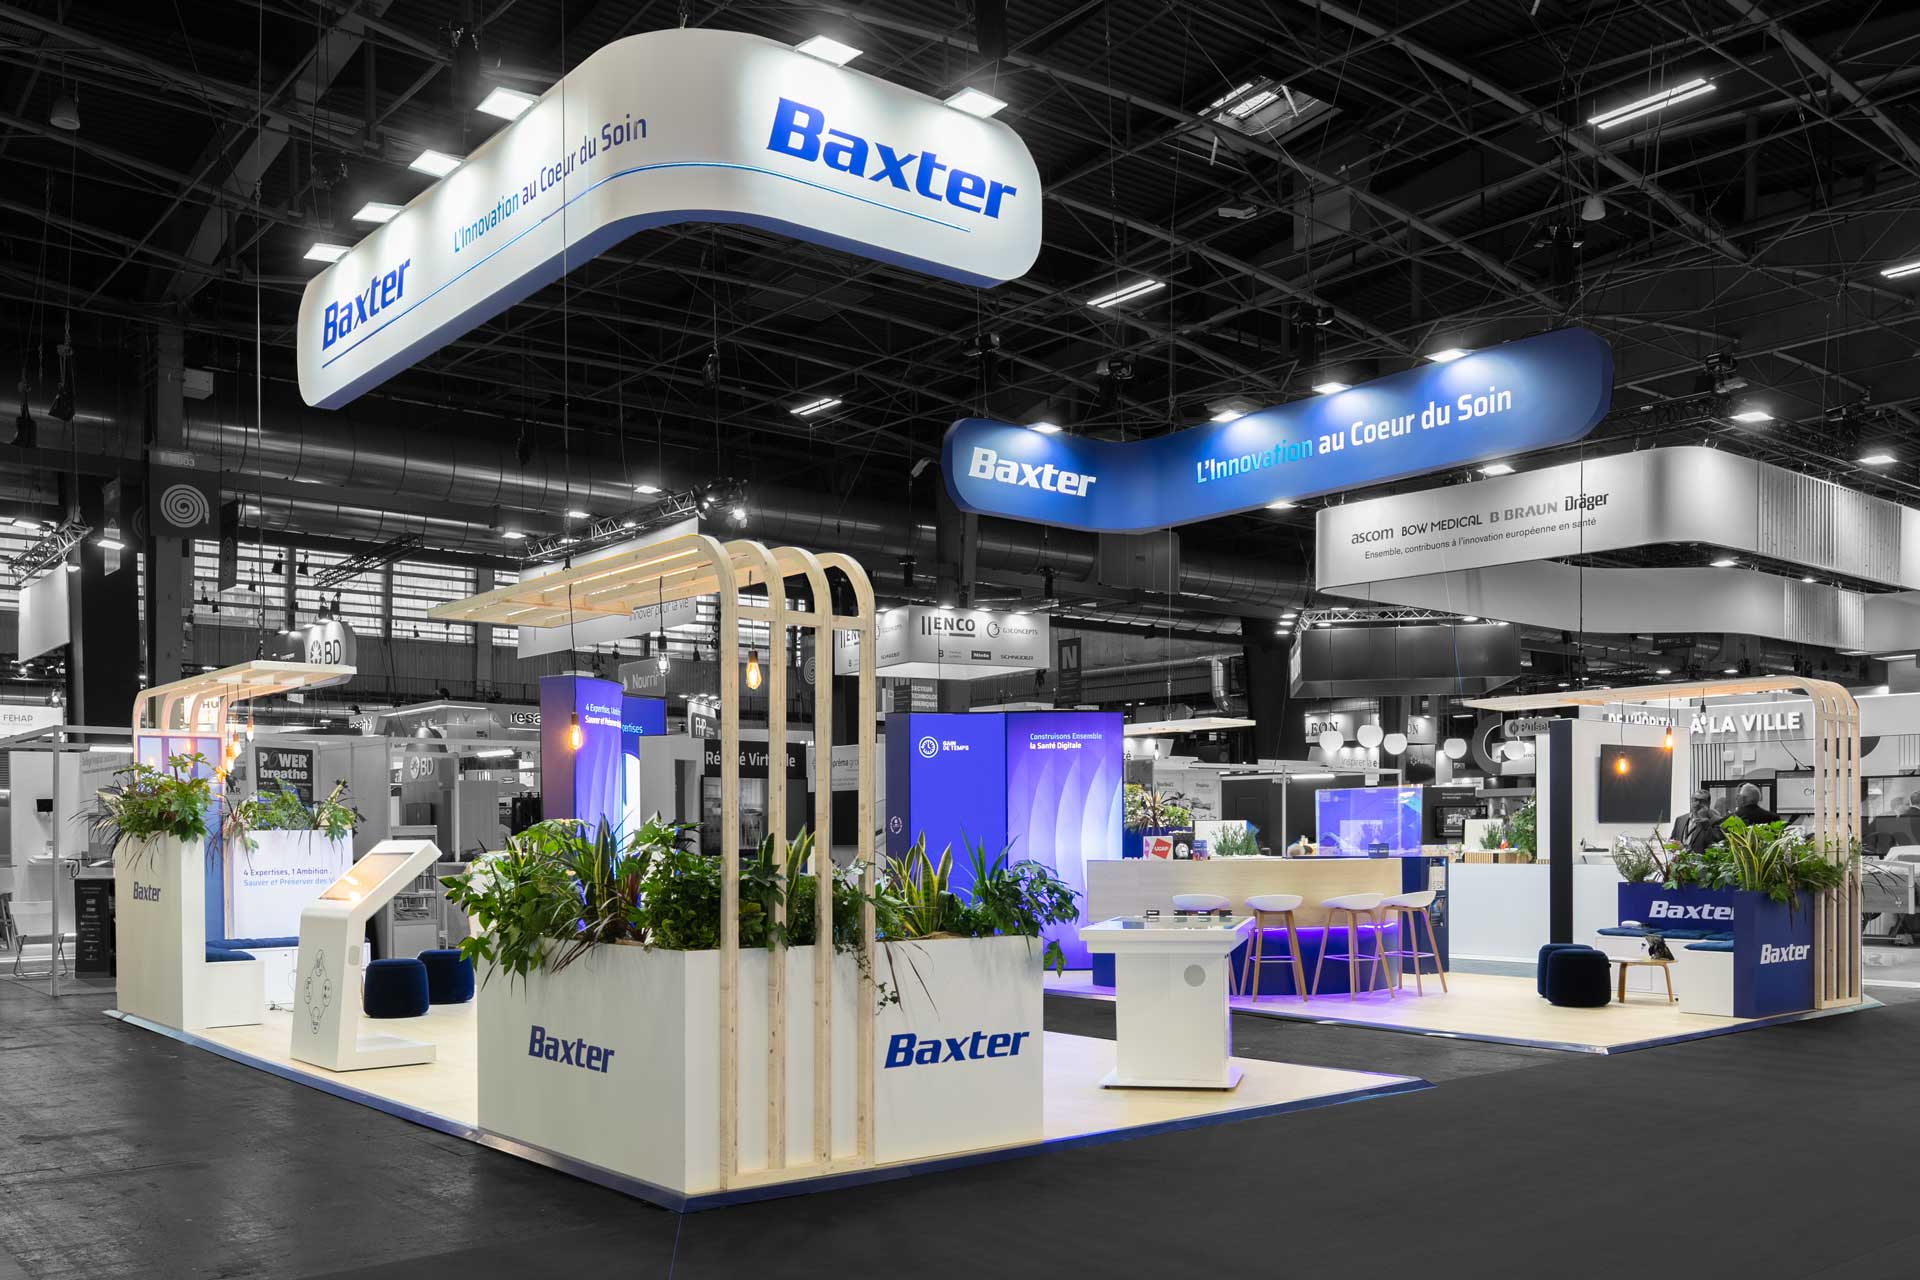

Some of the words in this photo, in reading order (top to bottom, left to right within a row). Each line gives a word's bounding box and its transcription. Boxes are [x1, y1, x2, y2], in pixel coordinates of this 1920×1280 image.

[767, 97, 1016, 219] Baxter
[454, 193, 518, 253] L'Innovation
[522, 184, 536, 205] au
[540, 152, 576, 193] Coeur
[580, 136, 597, 165] du
[602, 114, 646, 151] Soin
[322, 258, 410, 351] Baxter
[1196, 439, 1313, 484] L'Innovation
[1319, 431, 1345, 455] au
[1351, 415, 1415, 448] Coeur
[1422, 401, 1450, 430] du
[1458, 387, 1513, 418] Soin
[968, 446, 1096, 497] Baxter
[1352, 528, 1394, 545] ascom
[1401, 522, 1429, 537] BOW
[1431, 514, 1482, 532] MEDICAL
[1565, 492, 1609, 511] Dräger
[1365, 547, 1403, 560] Ensemble,
[1405, 540, 1449, 554] contribuons
[1451, 538, 1456, 547] à
[1458, 531, 1503, 546] l'innovation
[1506, 523, 1556, 541] européenne
[1558, 522, 1570, 532] en
[1572, 518, 1597, 530] santé
[325, 639, 342, 665] BD
[1709, 716, 1737, 734] LA
[1741, 711, 1801, 731] VILLE
[133, 881, 161, 902] Baxter
[1760, 943, 1810, 965] Baxter
[528, 1025, 615, 1074] Baxter
[884, 1030, 1030, 1070] Baxter
